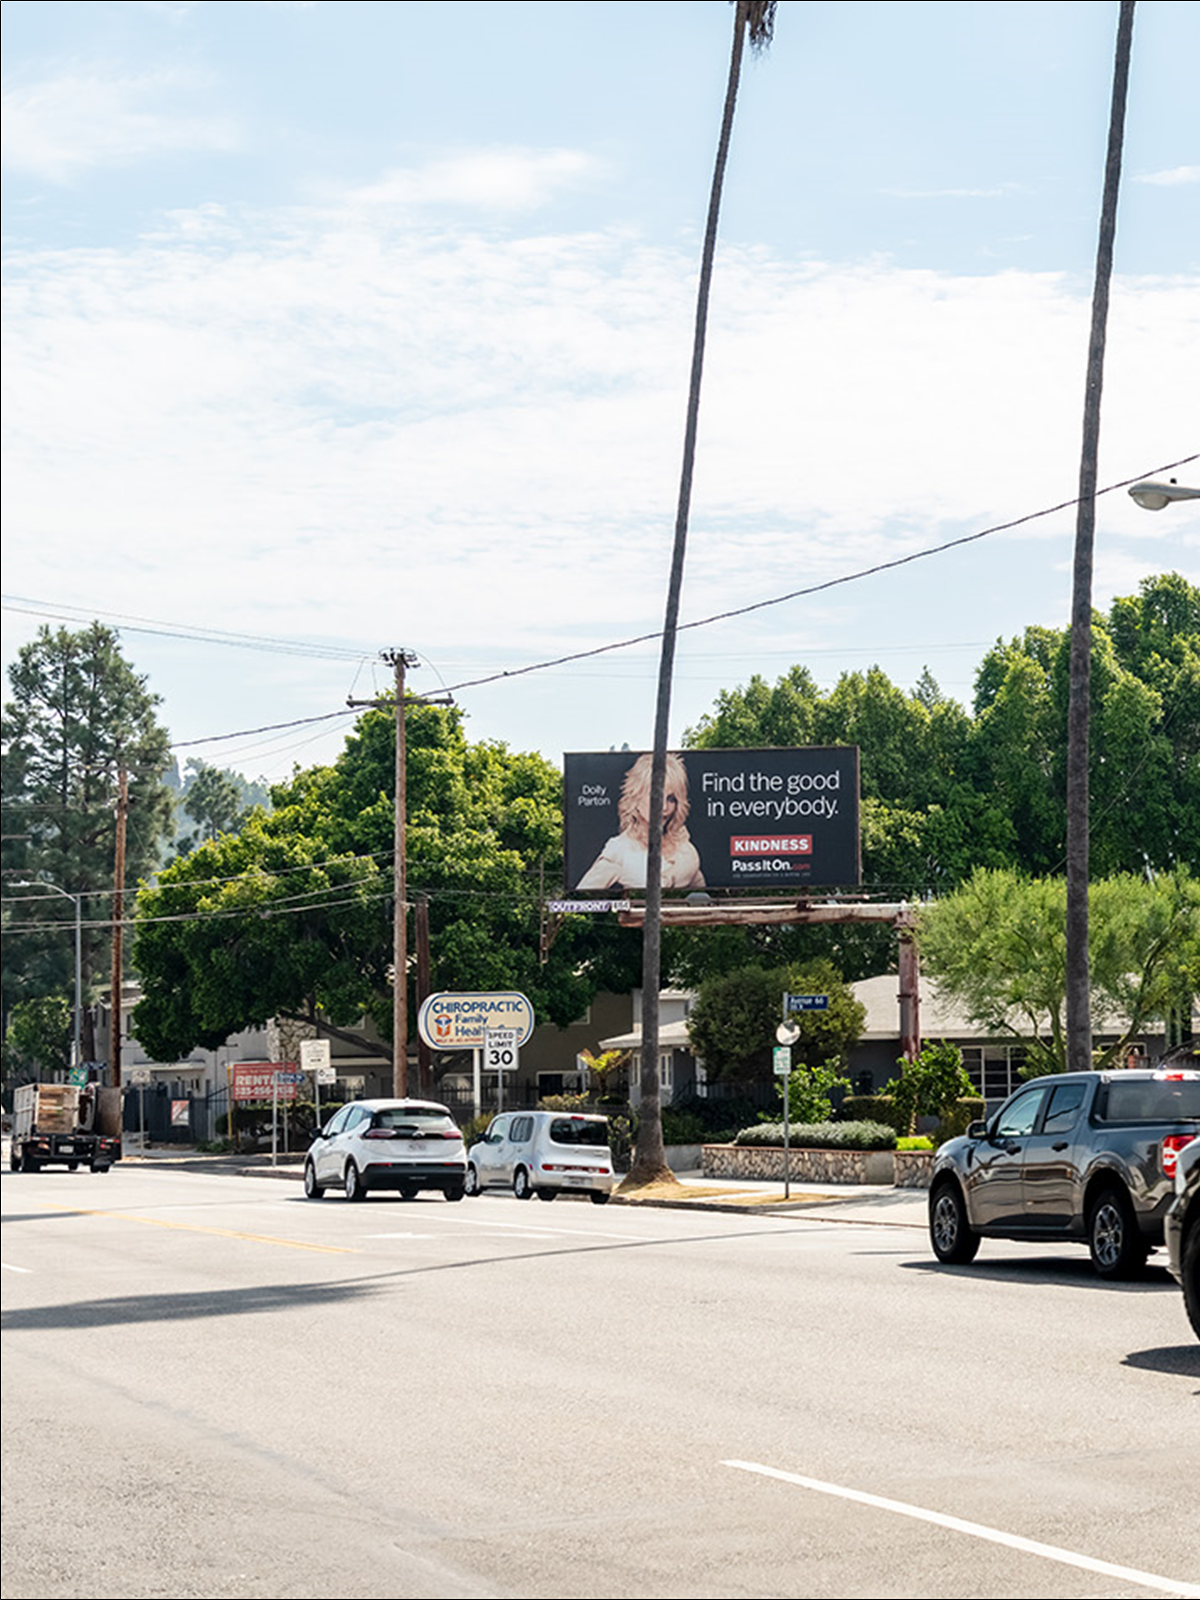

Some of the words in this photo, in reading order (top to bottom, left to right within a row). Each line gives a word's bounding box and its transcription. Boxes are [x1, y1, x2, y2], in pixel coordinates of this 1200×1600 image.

[702, 772, 745, 792] Find
[749, 772, 783, 791] the
[787, 770, 840, 795] good
[582, 784, 607, 796] Dolly
[578, 796, 611, 806] Parton
[707, 797, 725, 816] in
[729, 796, 839, 820] everybody.
[735, 839, 809, 852] KINDNESS
[732, 859, 811, 872] PassItOn.com
[432, 1001, 523, 1014] CHIROPRACTIC
[455, 1013, 489, 1025] Family
[455, 1025, 489, 1037] Healt
[488, 1031, 514, 1040] SPEED
[488, 1041, 513, 1049] LIMIT
[489, 1050, 513, 1065] 30
